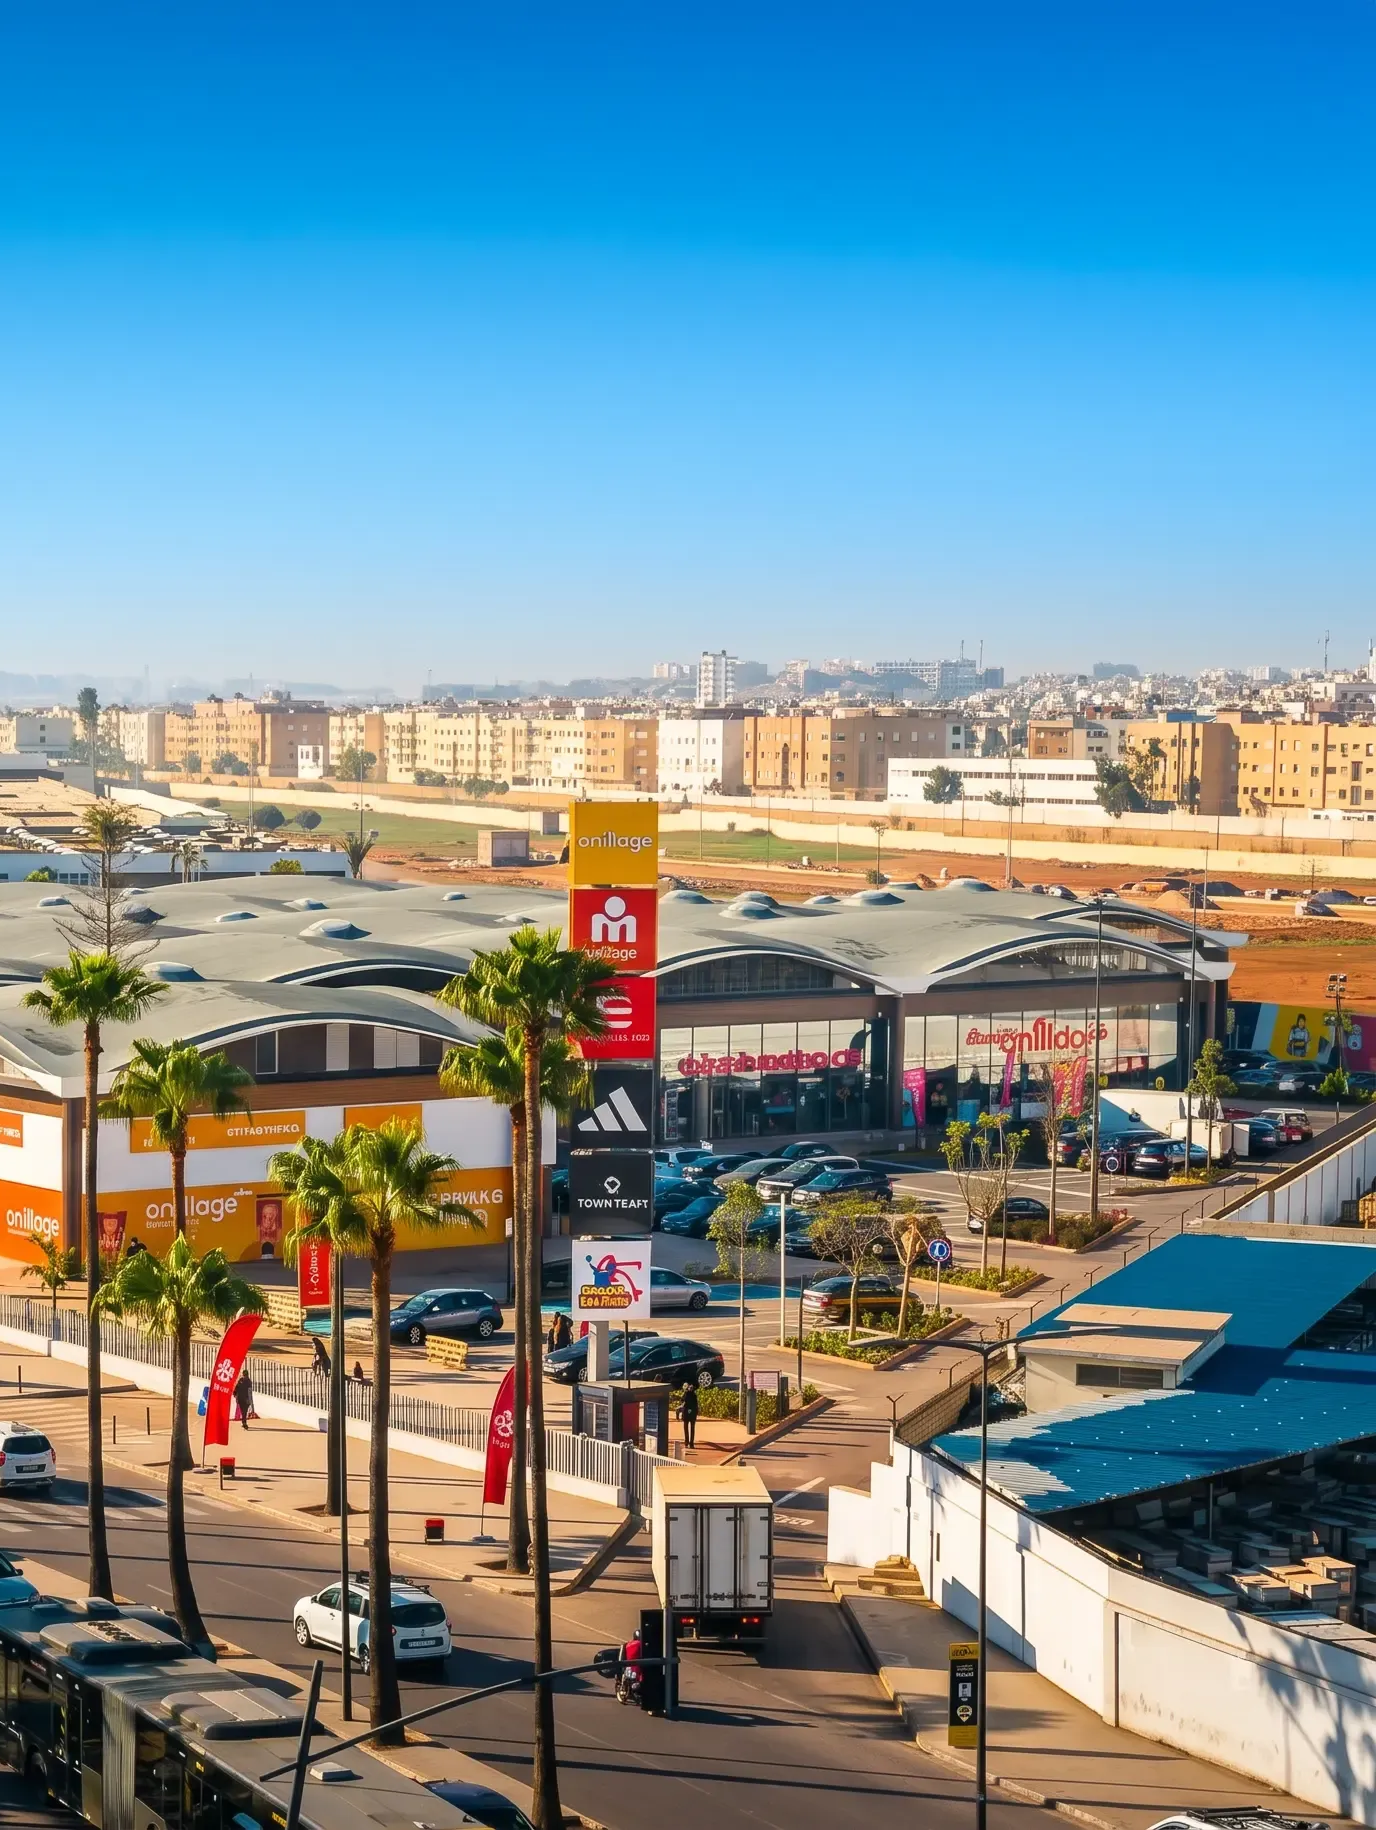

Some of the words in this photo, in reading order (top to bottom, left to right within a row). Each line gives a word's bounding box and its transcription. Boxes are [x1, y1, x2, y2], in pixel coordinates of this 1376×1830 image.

[578, 831, 653, 853] onillage
[146, 1195, 238, 1223] onllage
[577, 1198, 612, 1208] TOWN
